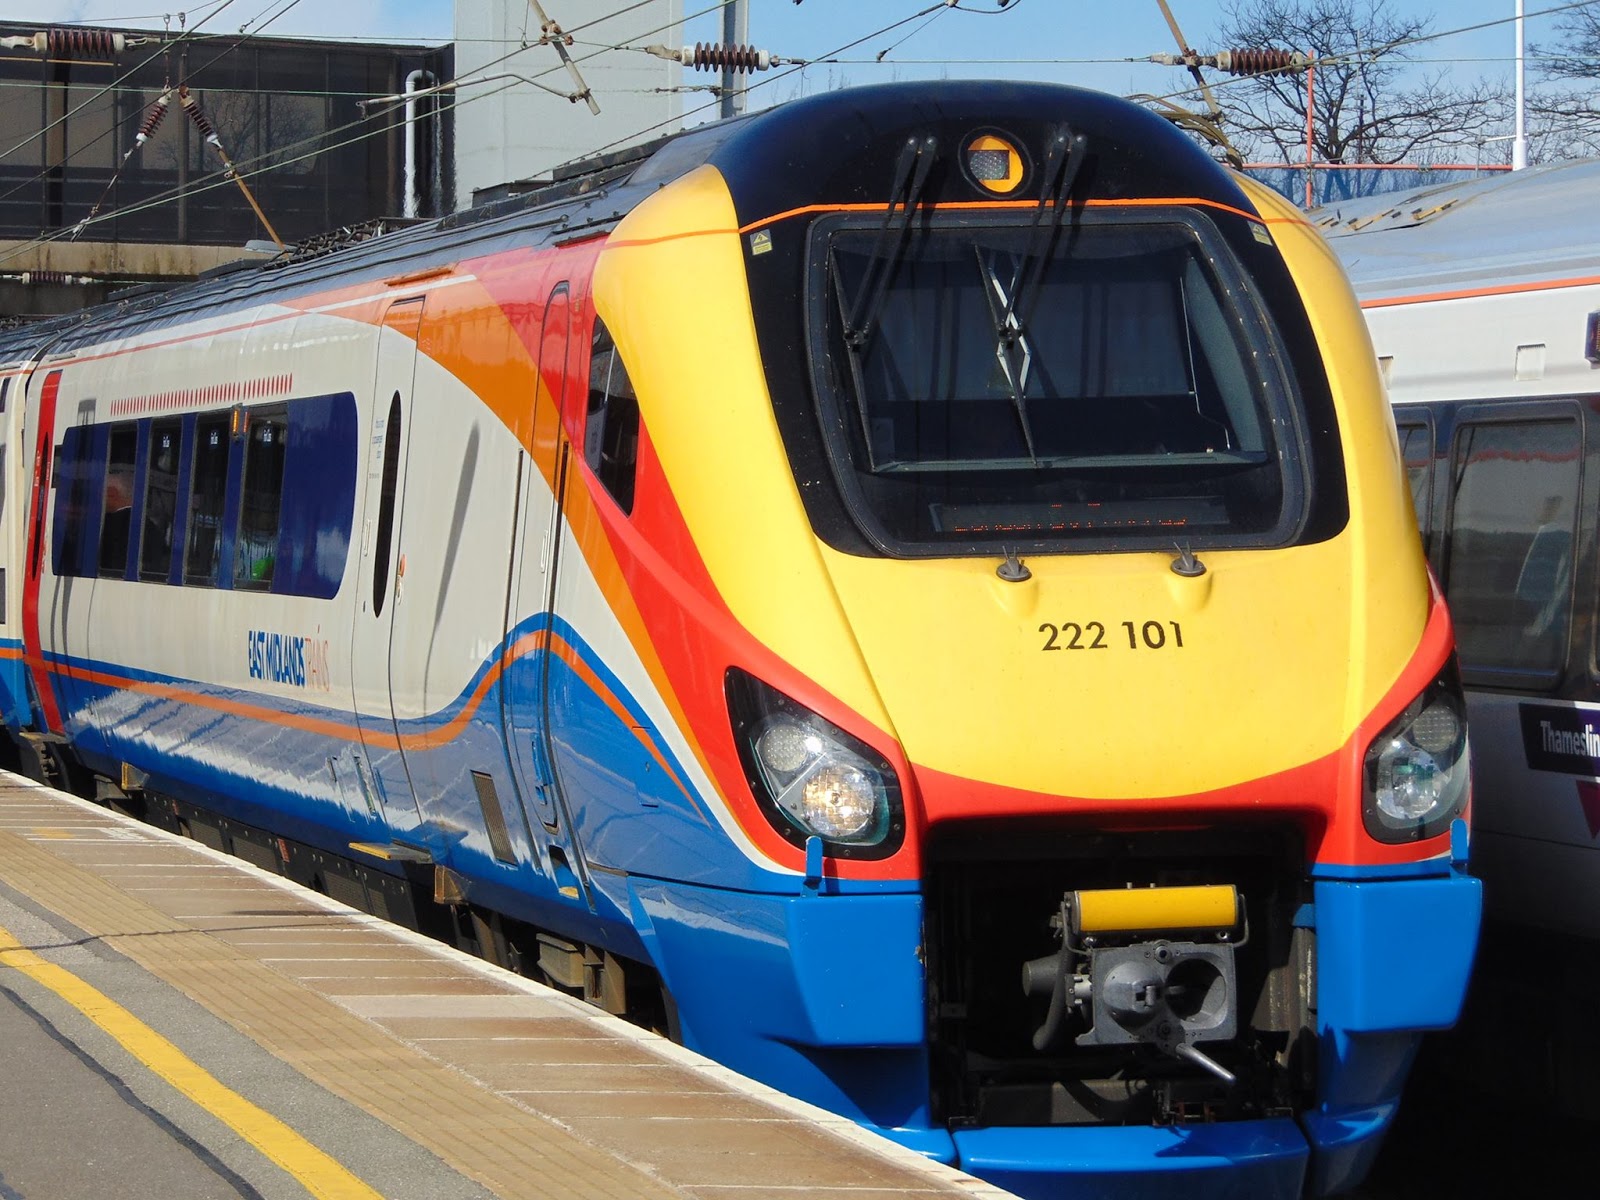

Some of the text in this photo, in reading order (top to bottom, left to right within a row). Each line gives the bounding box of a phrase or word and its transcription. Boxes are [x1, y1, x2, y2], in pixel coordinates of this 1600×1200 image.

[248, 624, 330, 692] EAST MIDLANDS TRAINS
[1038, 620, 1183, 651] 222 101
